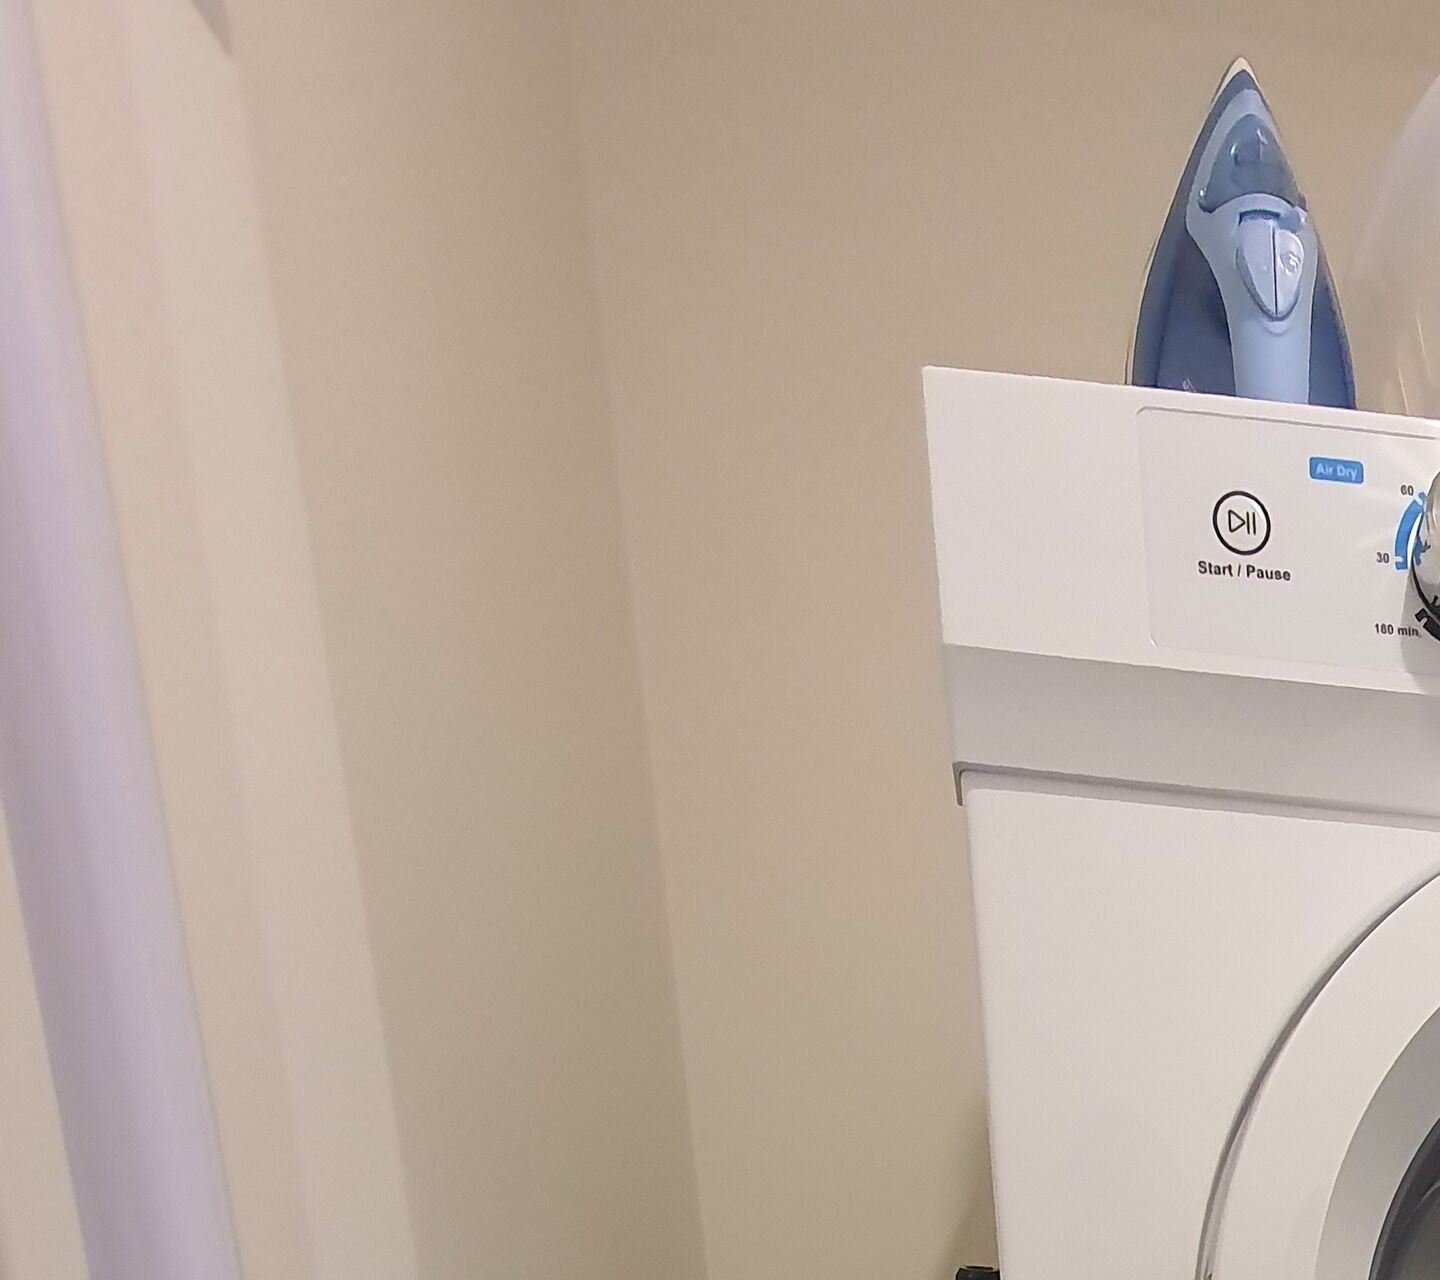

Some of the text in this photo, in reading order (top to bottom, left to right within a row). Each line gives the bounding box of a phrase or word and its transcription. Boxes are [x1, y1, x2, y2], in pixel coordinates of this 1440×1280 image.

[1316, 463, 1357, 481] Air Dry
[1400, 485, 1415, 497] 60
[1375, 552, 1390, 564] 30
[1198, 560, 1233, 577] Start
[1246, 564, 1291, 581] Pause
[1375, 623, 1394, 636] 180
